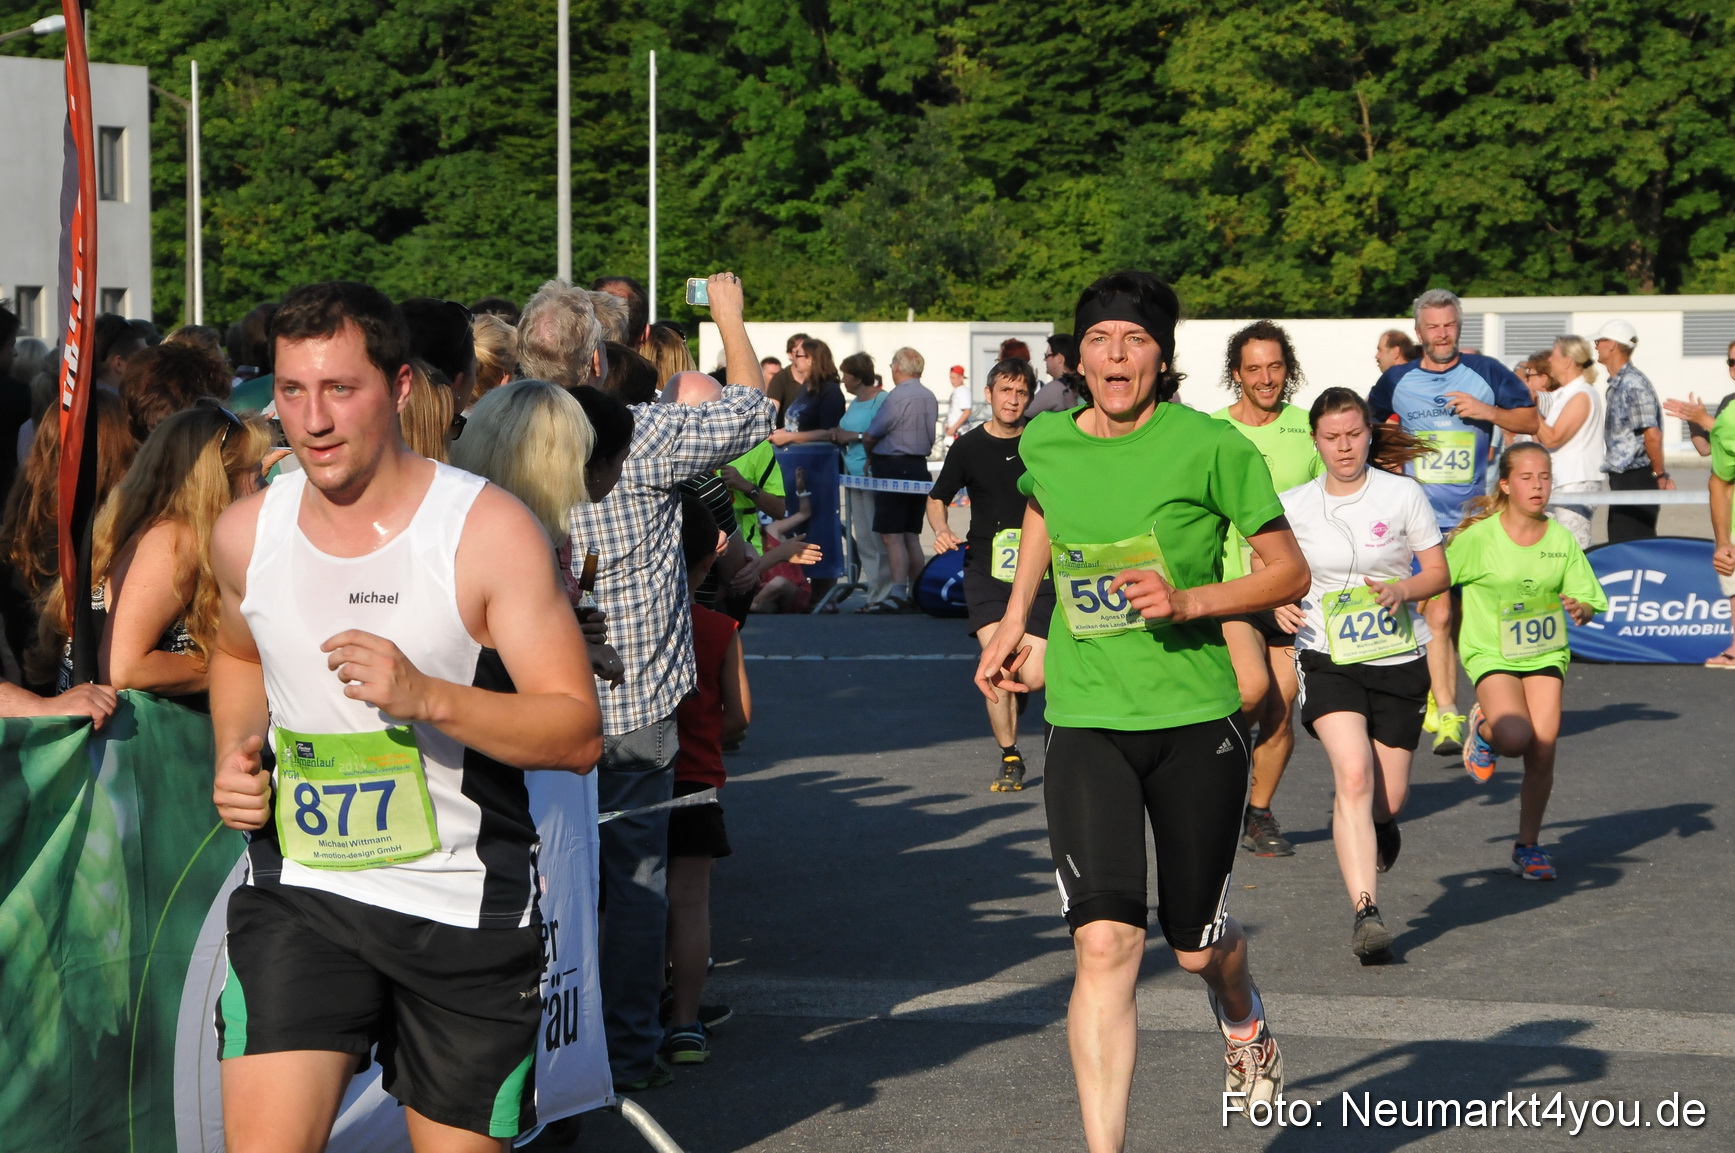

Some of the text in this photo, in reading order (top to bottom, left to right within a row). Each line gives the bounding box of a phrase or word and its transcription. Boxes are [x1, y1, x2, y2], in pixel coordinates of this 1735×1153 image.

[1433, 420, 1452, 428] TEAM
[1001, 548, 1020, 569] 2
[349, 591, 399, 605] Michael
[1071, 575, 1136, 613] 56
[1100, 614, 1120, 622] Agnes
[1339, 606, 1397, 643] 426
[1076, 623, 1098, 631] Kliniken
[1510, 616, 1557, 645] 190
[1617, 623, 1734, 637] AUTOMOBIL
[294, 779, 396, 837] 877
[318, 834, 392, 849] Michael Wittmann
[313, 845, 402, 860] M-motion-design GmbH
